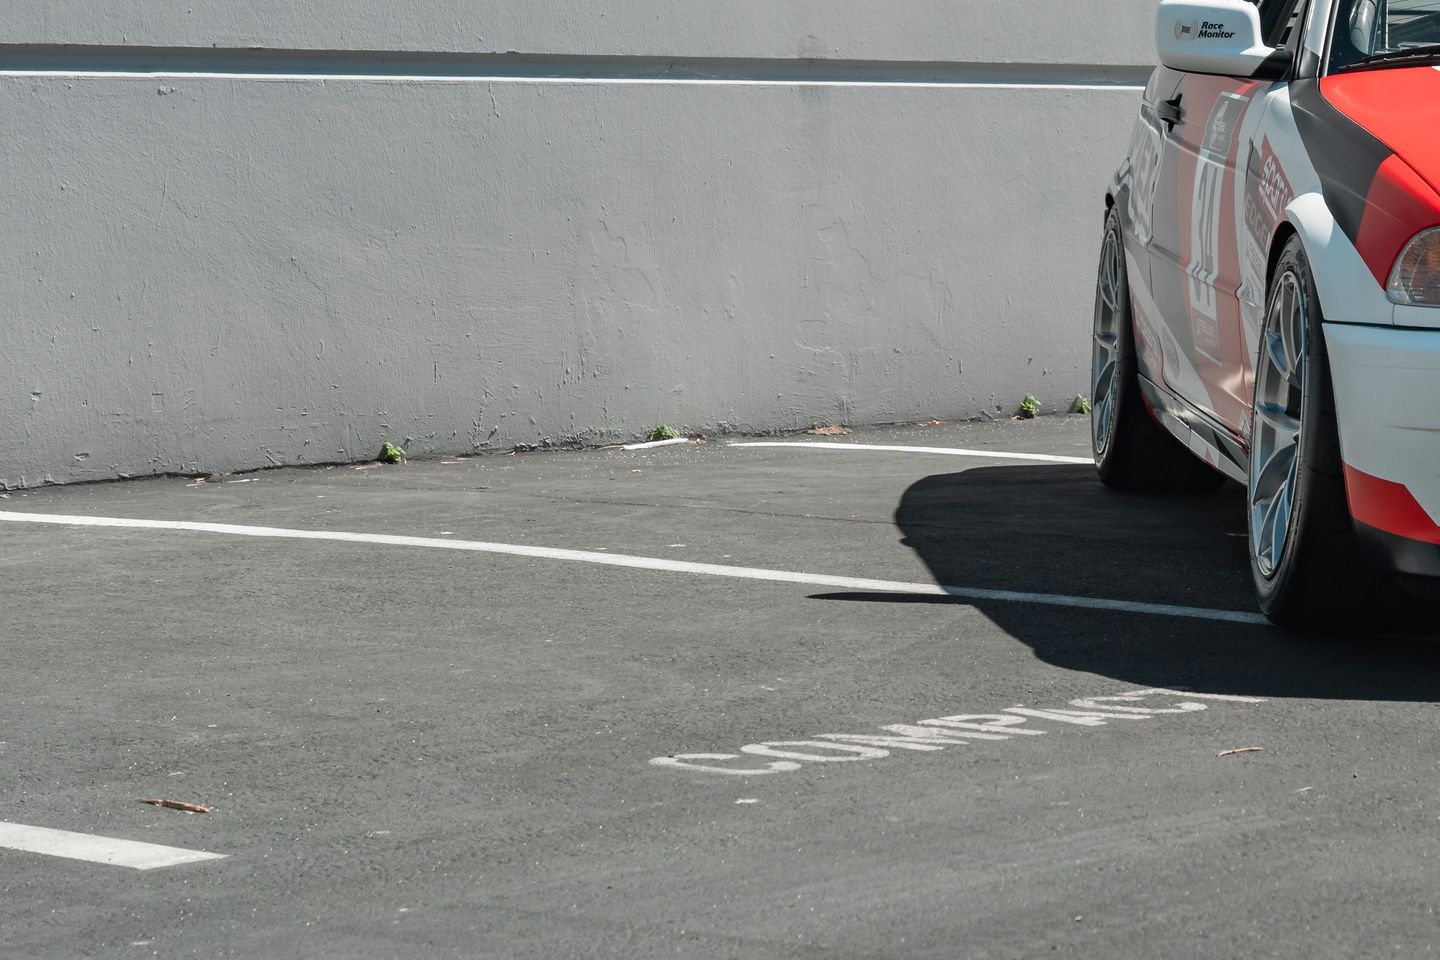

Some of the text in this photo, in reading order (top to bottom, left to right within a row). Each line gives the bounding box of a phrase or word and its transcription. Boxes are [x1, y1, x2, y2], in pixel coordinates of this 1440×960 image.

[1201, 21, 1224, 30] Race
[1198, 30, 1235, 39] Monitor
[647, 688, 1268, 775] COMPACT
